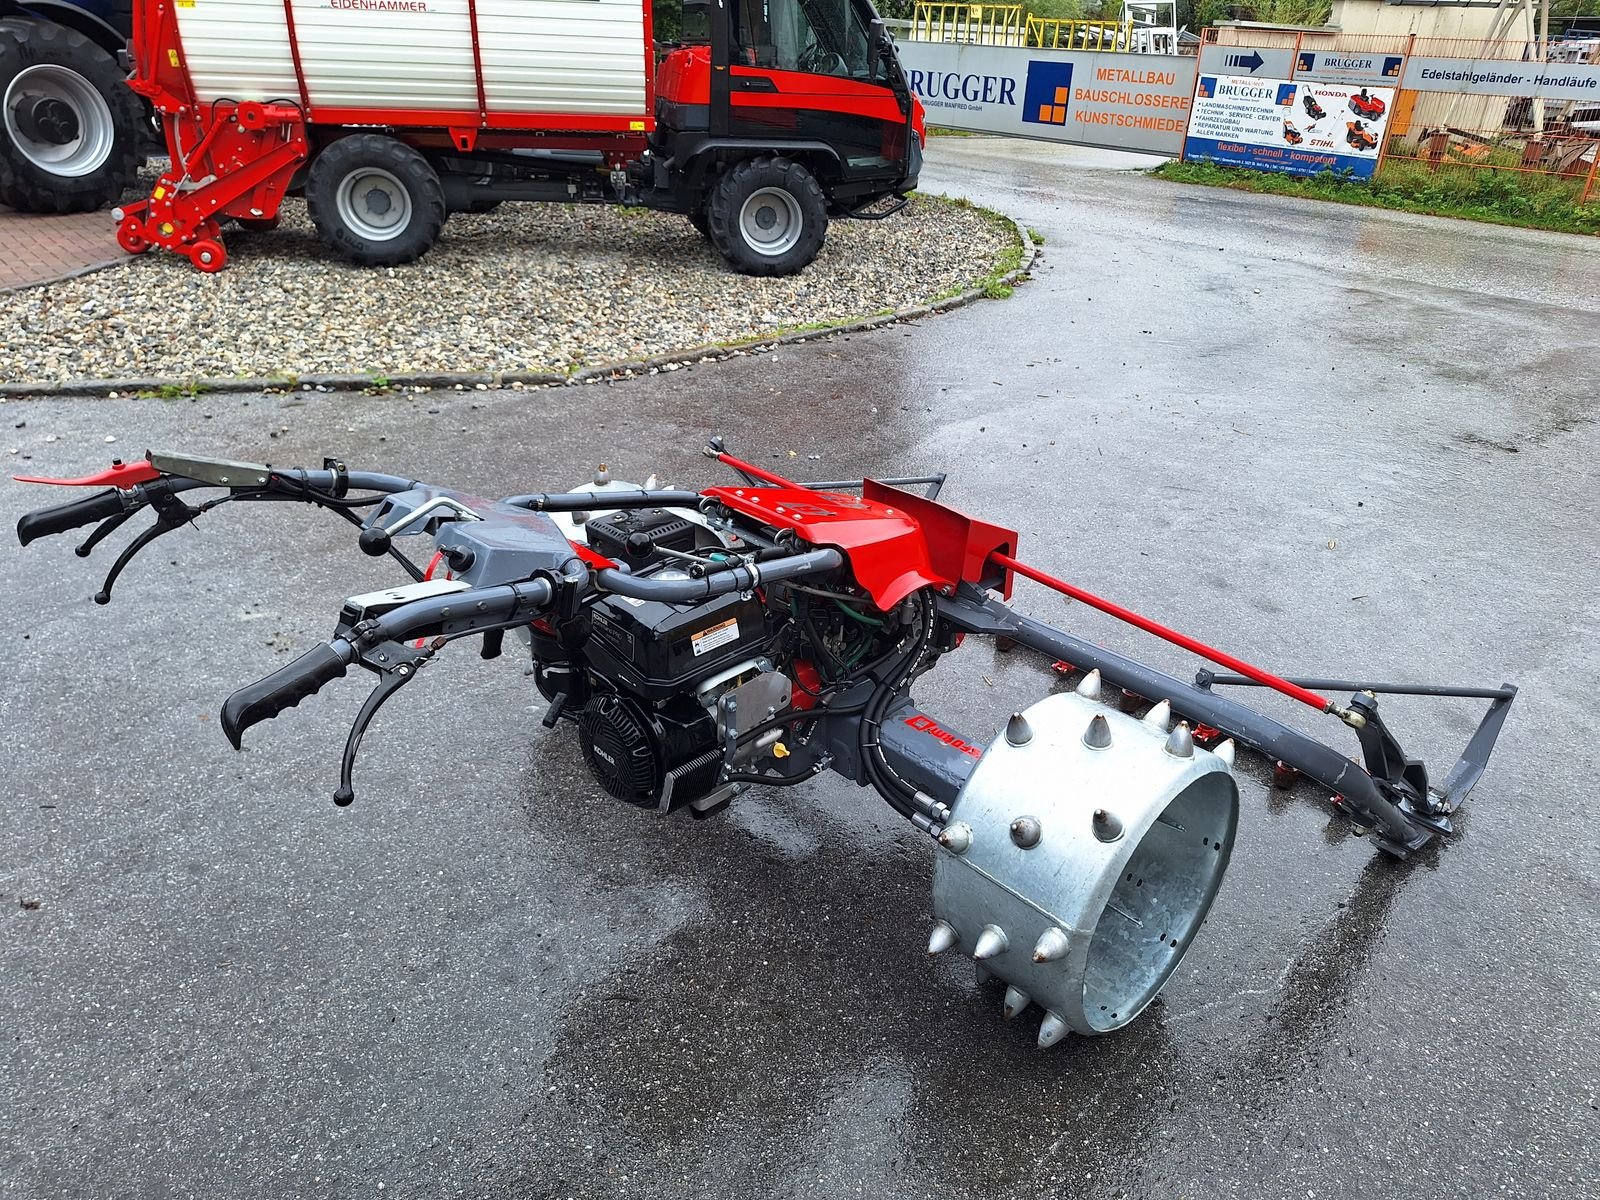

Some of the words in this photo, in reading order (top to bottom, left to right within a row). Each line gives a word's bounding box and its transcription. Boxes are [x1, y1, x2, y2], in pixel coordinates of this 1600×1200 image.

[1324, 58, 1372, 69] BRUGGER
[1096, 68, 1175, 86] METALLBAU
[1421, 68, 1523, 85] Edelstahlgeländer
[1533, 74, 1597, 88] Handläufe
[904, 69, 1017, 105] RUGGER
[1218, 84, 1273, 99] BRUGGER
[1313, 89, 1348, 98] HONDA
[1200, 108, 1224, 116] TECHNIK
[1229, 111, 1253, 119] SERVICE
[1258, 114, 1281, 123] CENTER
[1201, 102, 1274, 114] LANDMASCHINENTECHNIK
[1075, 110, 1185, 133] KUNSTSCHMIEDE
[1199, 116, 1241, 125] FAHRZEUGBAU
[1197, 122, 1231, 131] REPARATUR
[1244, 127, 1274, 136] WARTUNG
[1214, 131, 1239, 139] MARKEN
[1309, 138, 1334, 148] STIHL
[1217, 141, 1247, 154] flexibel
[1252, 147, 1284, 158] schnell
[1290, 150, 1337, 165] kompetent
[593, 744, 616, 767] KOHLER
